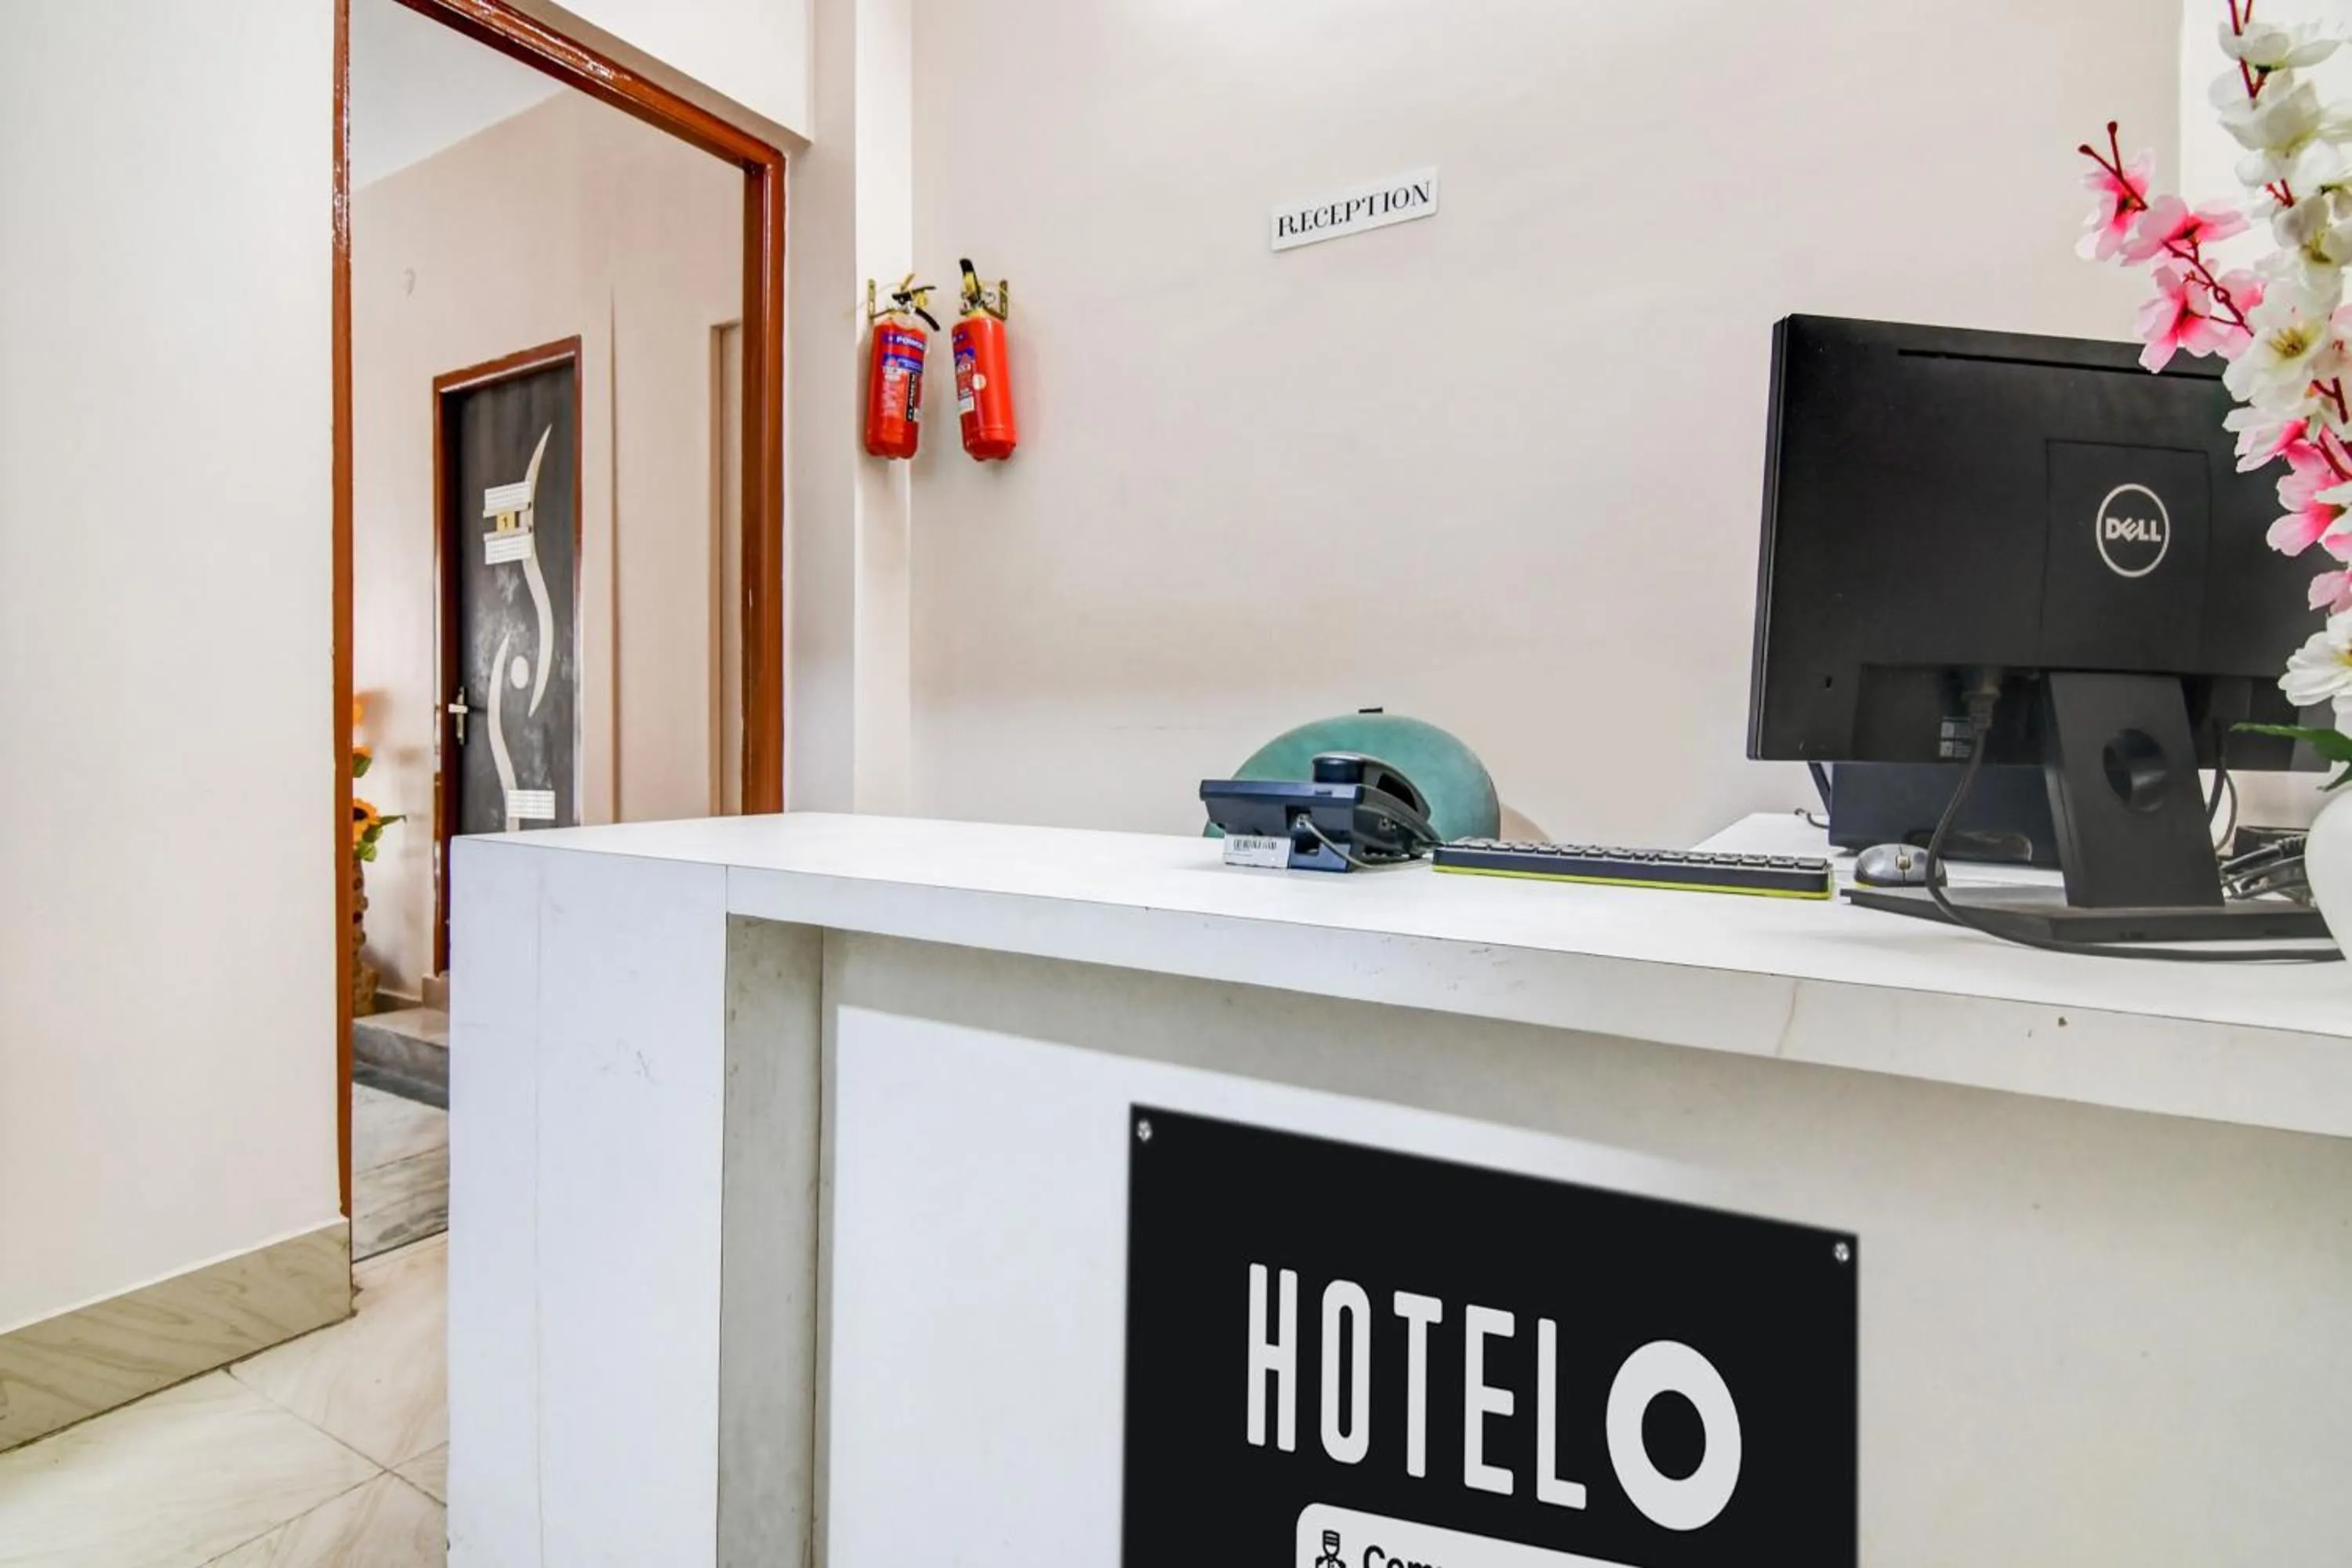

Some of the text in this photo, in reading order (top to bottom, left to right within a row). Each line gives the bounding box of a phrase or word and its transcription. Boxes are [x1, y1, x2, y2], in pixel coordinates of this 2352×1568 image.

[1278, 181, 1430, 238] RECEPTION
[2105, 517, 2161, 542] DELL
[1247, 1263, 1587, 1510] HOTEL
